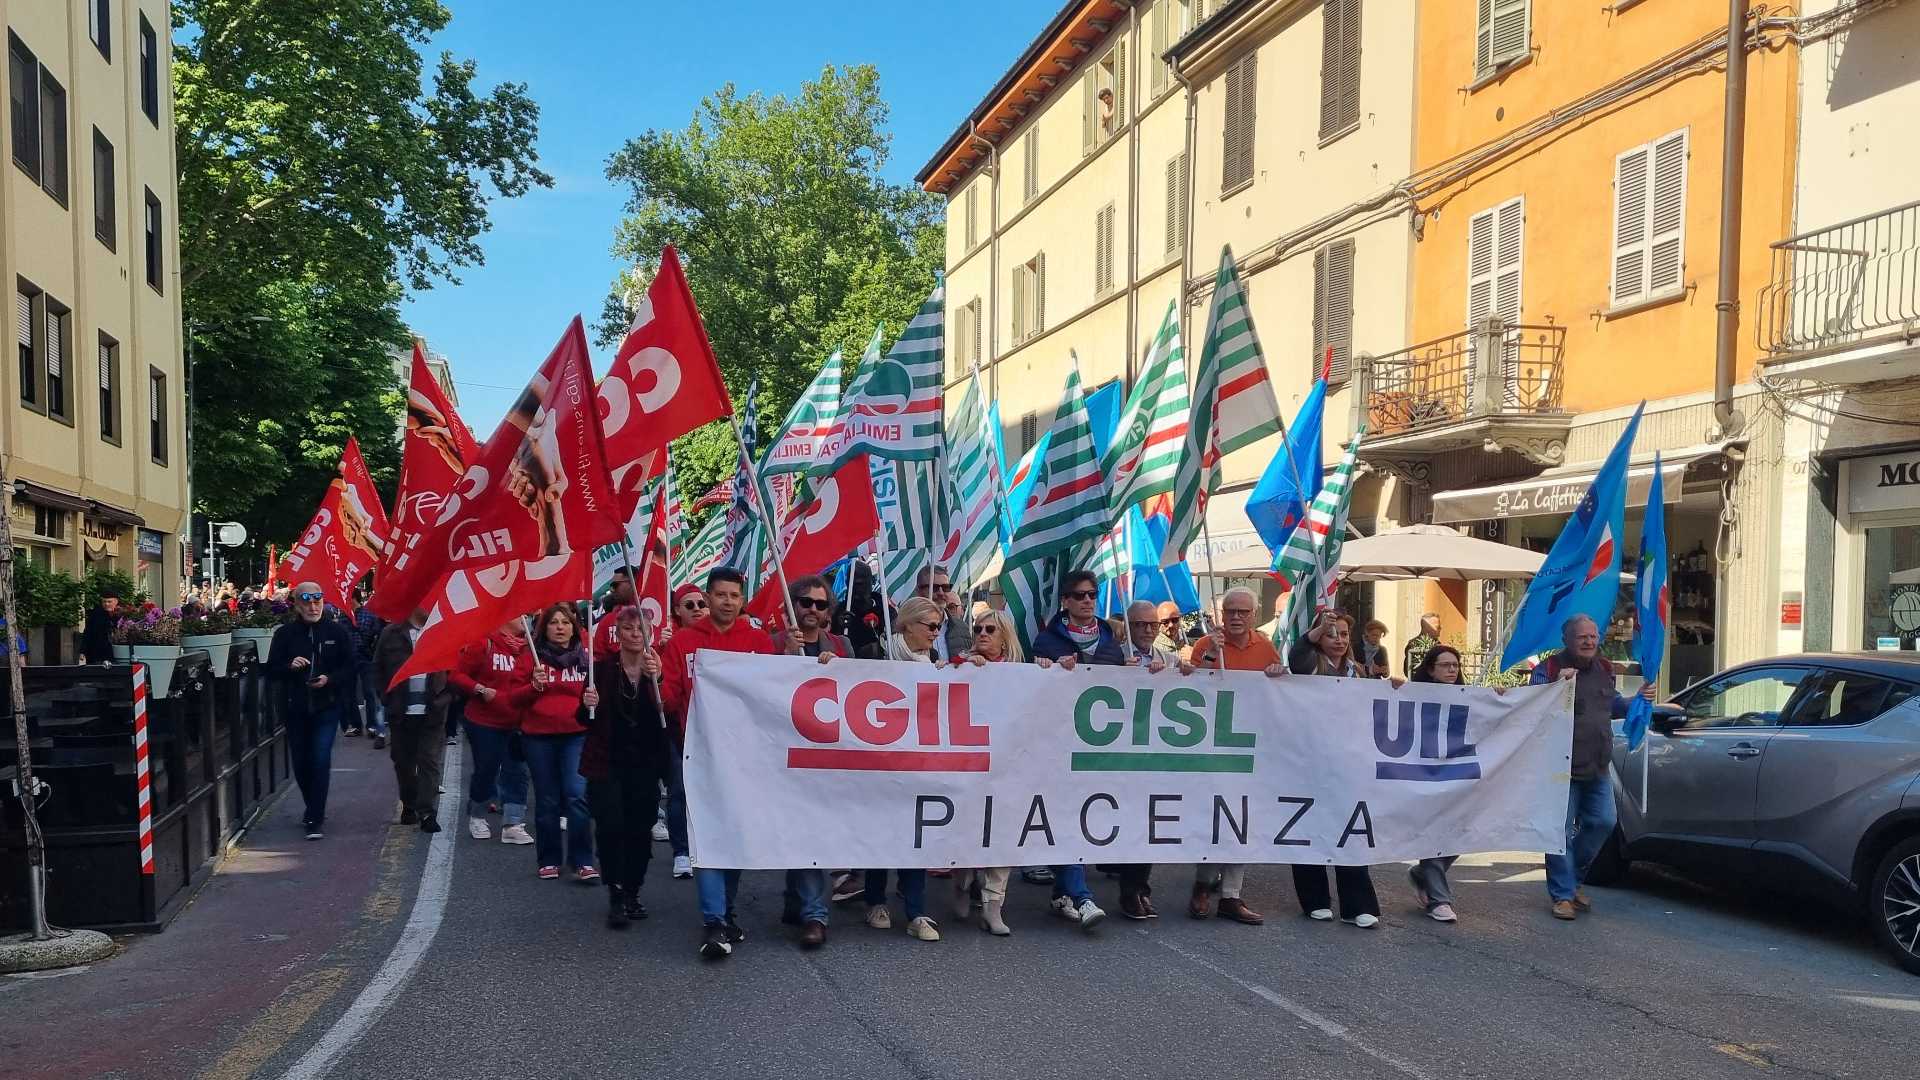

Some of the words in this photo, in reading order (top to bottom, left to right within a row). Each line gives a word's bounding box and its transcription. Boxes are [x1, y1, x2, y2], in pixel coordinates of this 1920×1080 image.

[1510, 489, 1529, 511] La
[1534, 485, 1584, 512] Caffettie
[789, 677, 991, 746] CGIL
[1072, 685, 1257, 748] CISL
[1372, 698, 1477, 759] UIL
[914, 792, 1377, 849] PIACENZA
